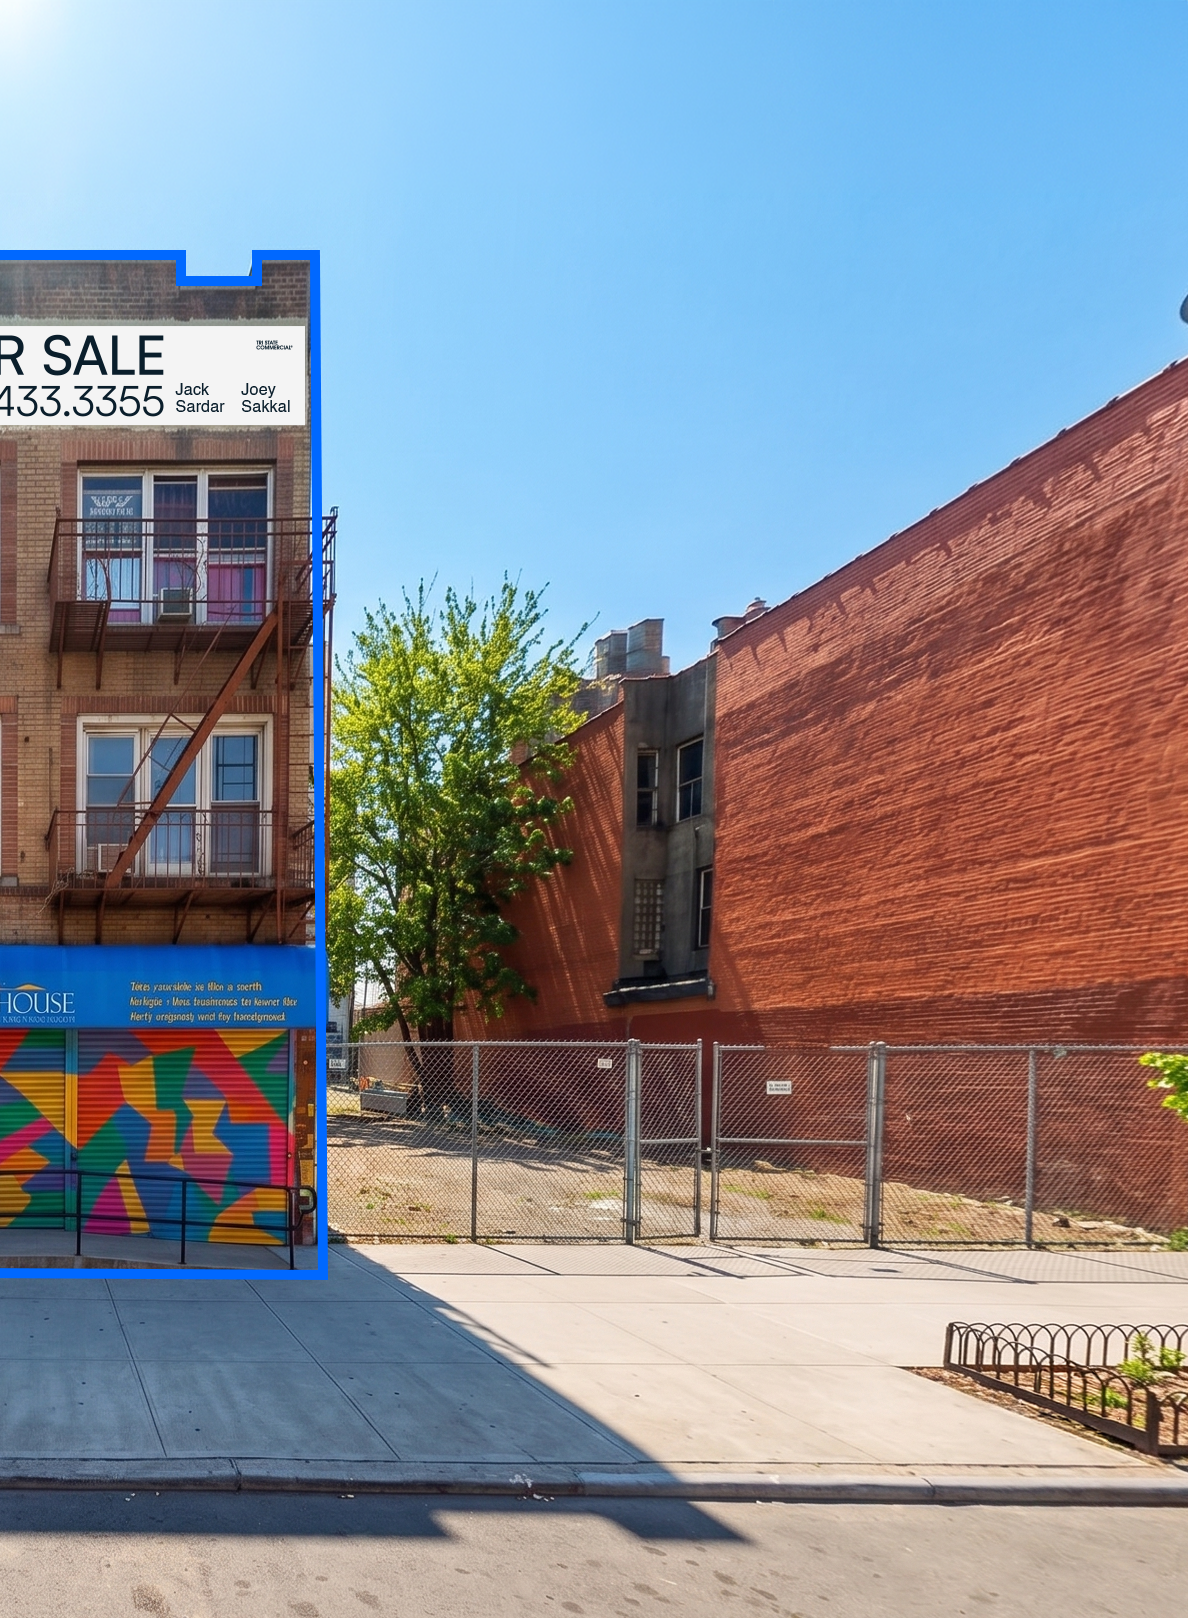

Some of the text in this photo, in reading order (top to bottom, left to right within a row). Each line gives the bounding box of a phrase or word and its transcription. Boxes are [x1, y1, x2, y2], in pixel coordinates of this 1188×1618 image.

[43, 334, 164, 376] SALE
[175, 382, 210, 396] Jack
[241, 382, 276, 399] Joey
[175, 399, 225, 413] Sardar
[241, 399, 291, 413] Sakkal
